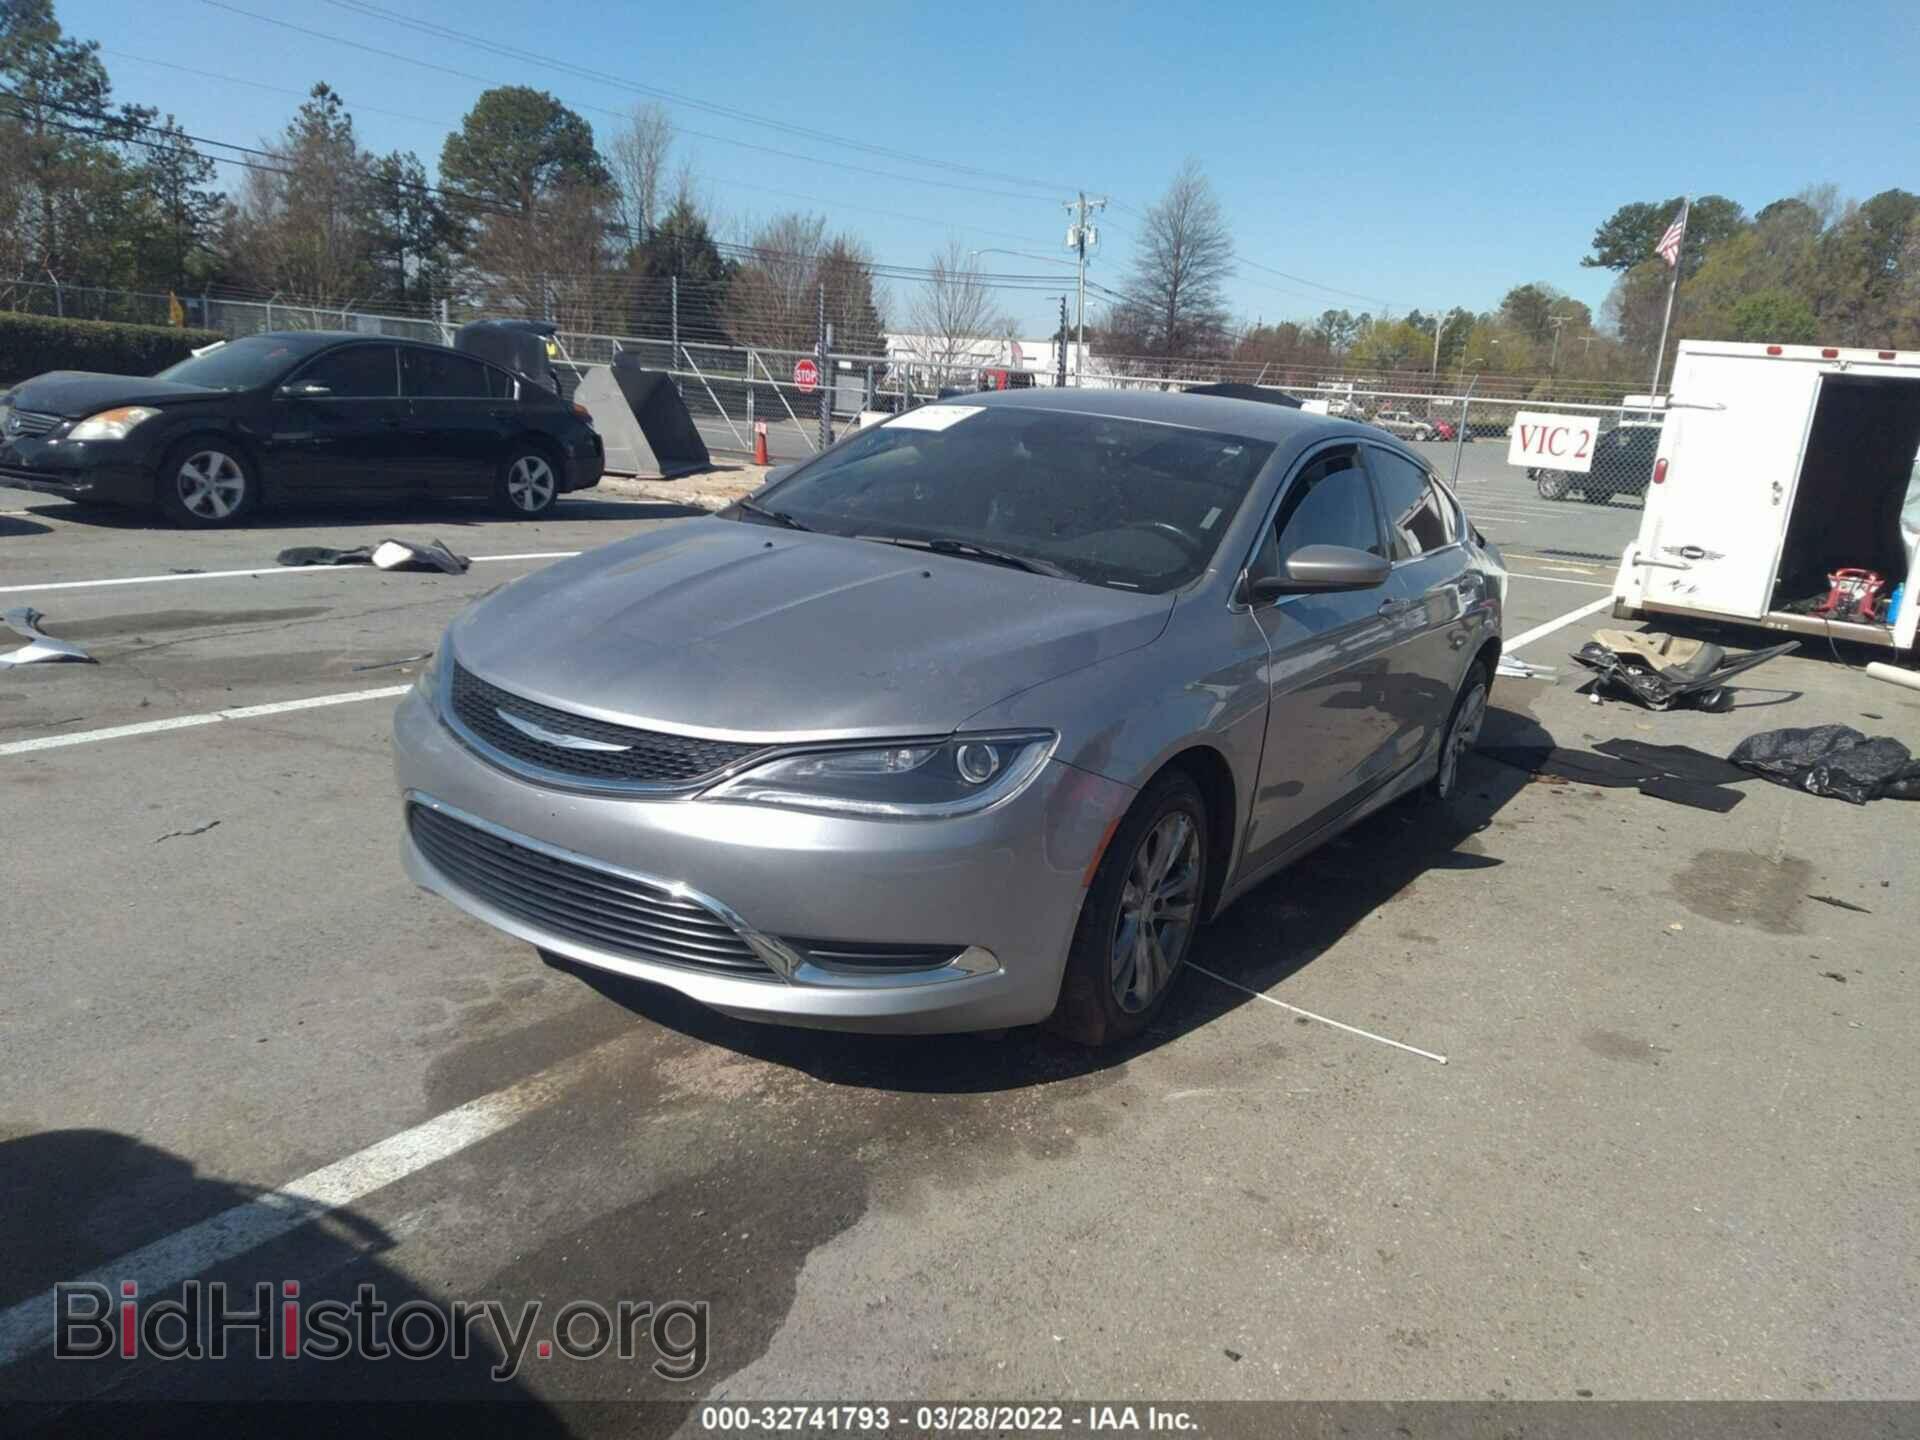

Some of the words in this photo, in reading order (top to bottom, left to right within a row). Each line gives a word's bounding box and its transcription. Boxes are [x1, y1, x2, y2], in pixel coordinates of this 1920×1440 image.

[796, 369, 816, 382] STOP
[1520, 424, 1569, 456] VIC
[1574, 430, 1590, 458] 2
